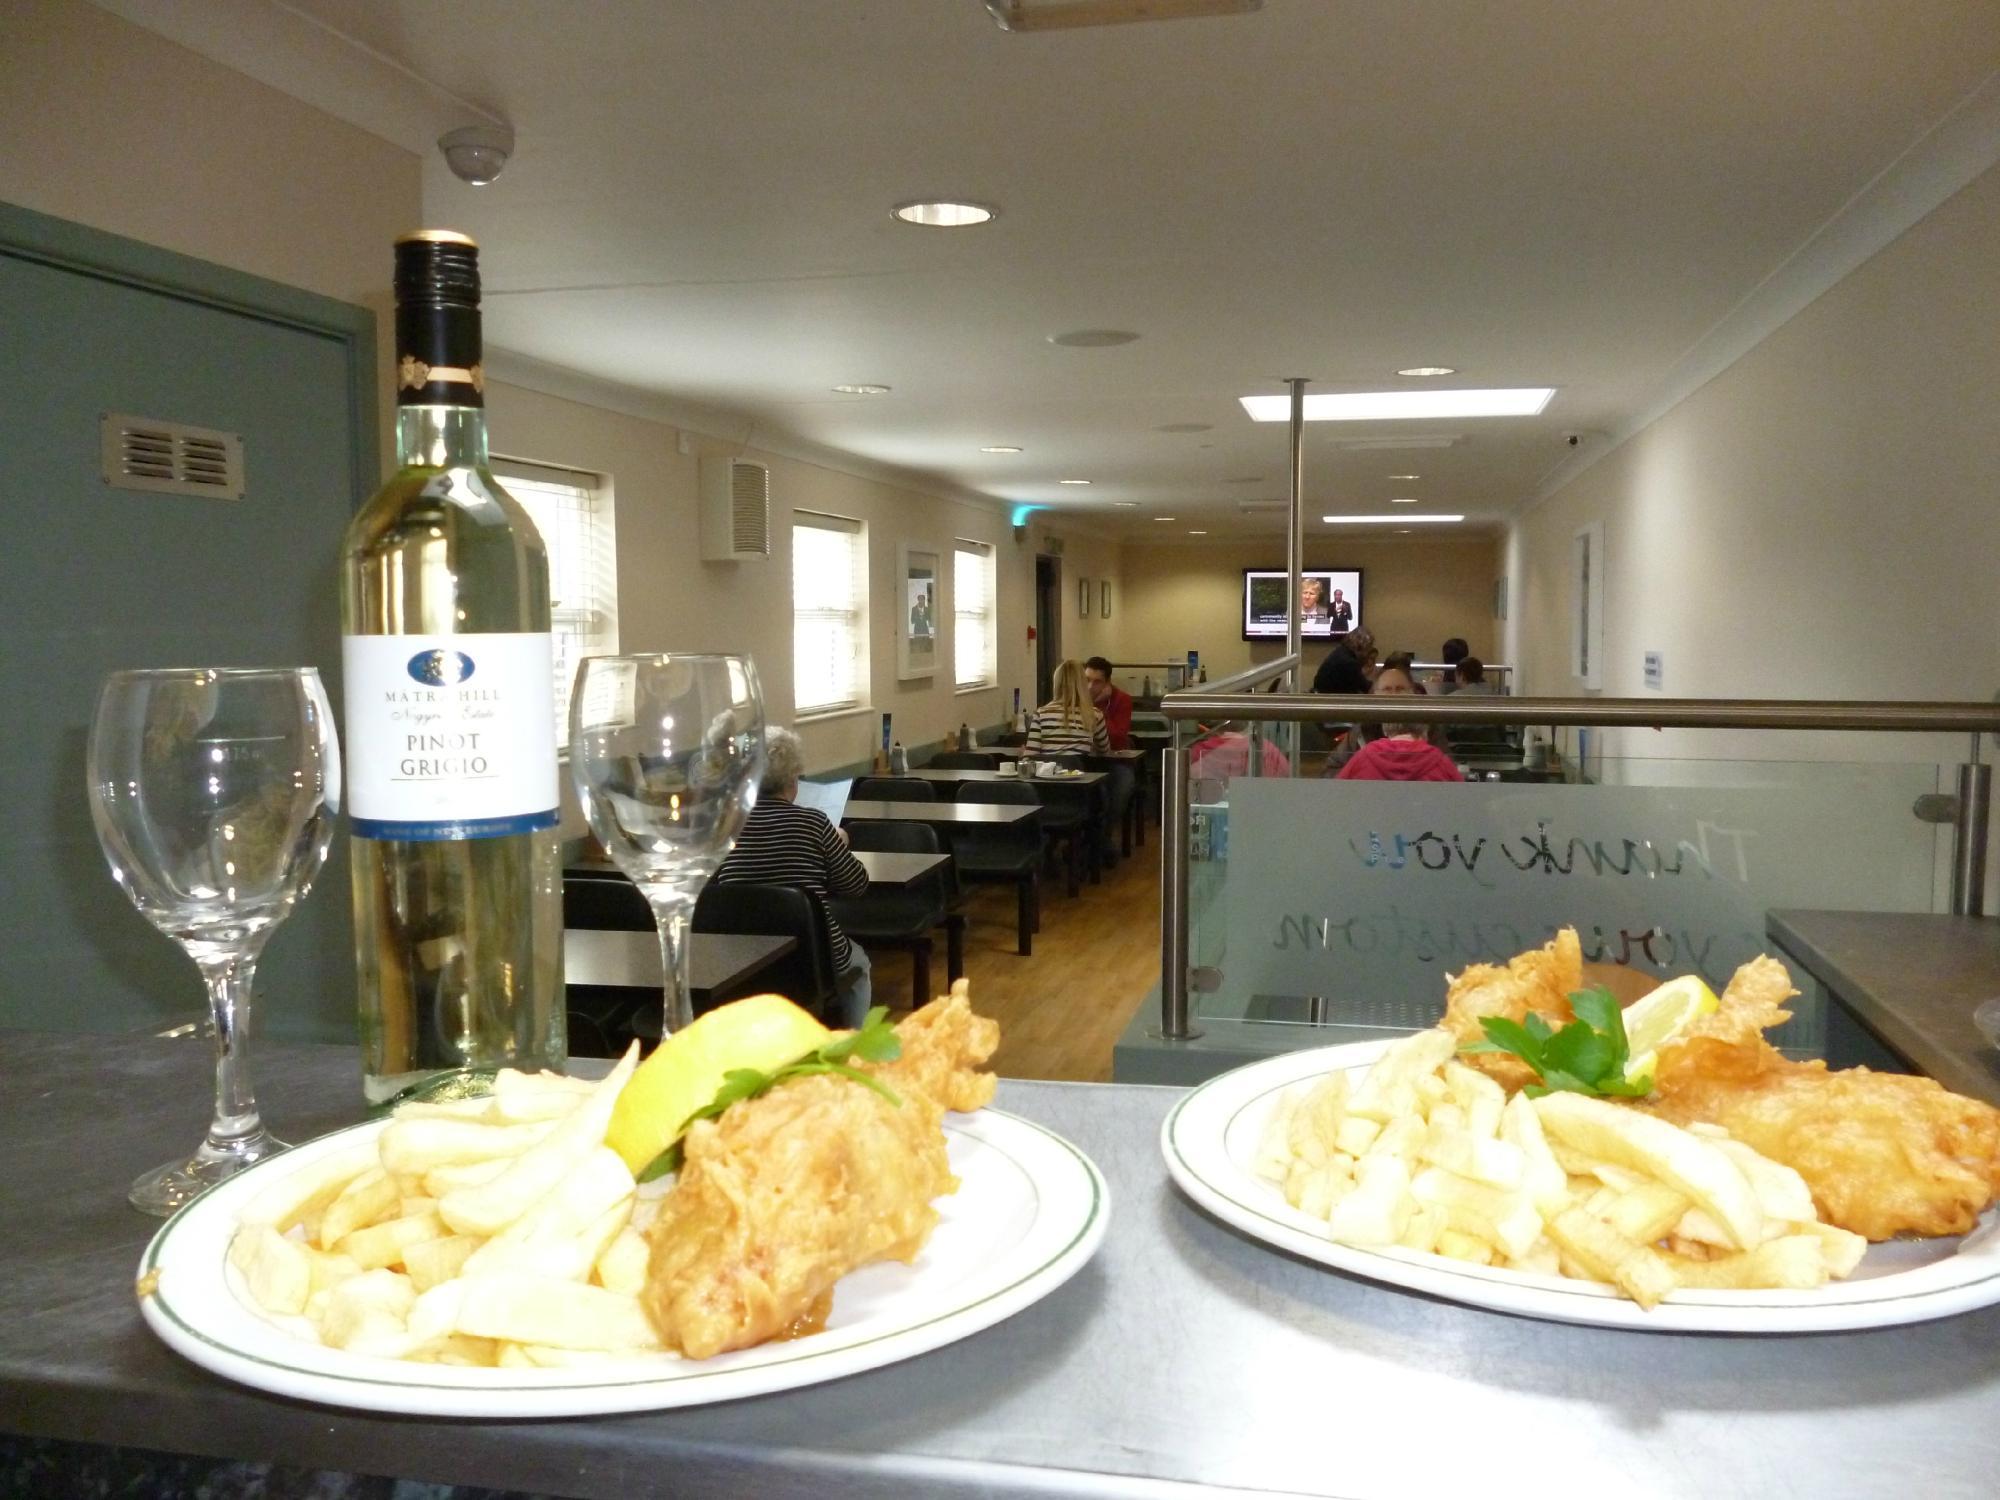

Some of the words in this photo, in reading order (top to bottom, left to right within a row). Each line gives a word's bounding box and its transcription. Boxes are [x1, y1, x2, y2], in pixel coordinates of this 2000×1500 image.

[459, 688, 501, 702] HILL
[407, 733, 480, 752] PINOT
[400, 756, 488, 776] GRIGIO
